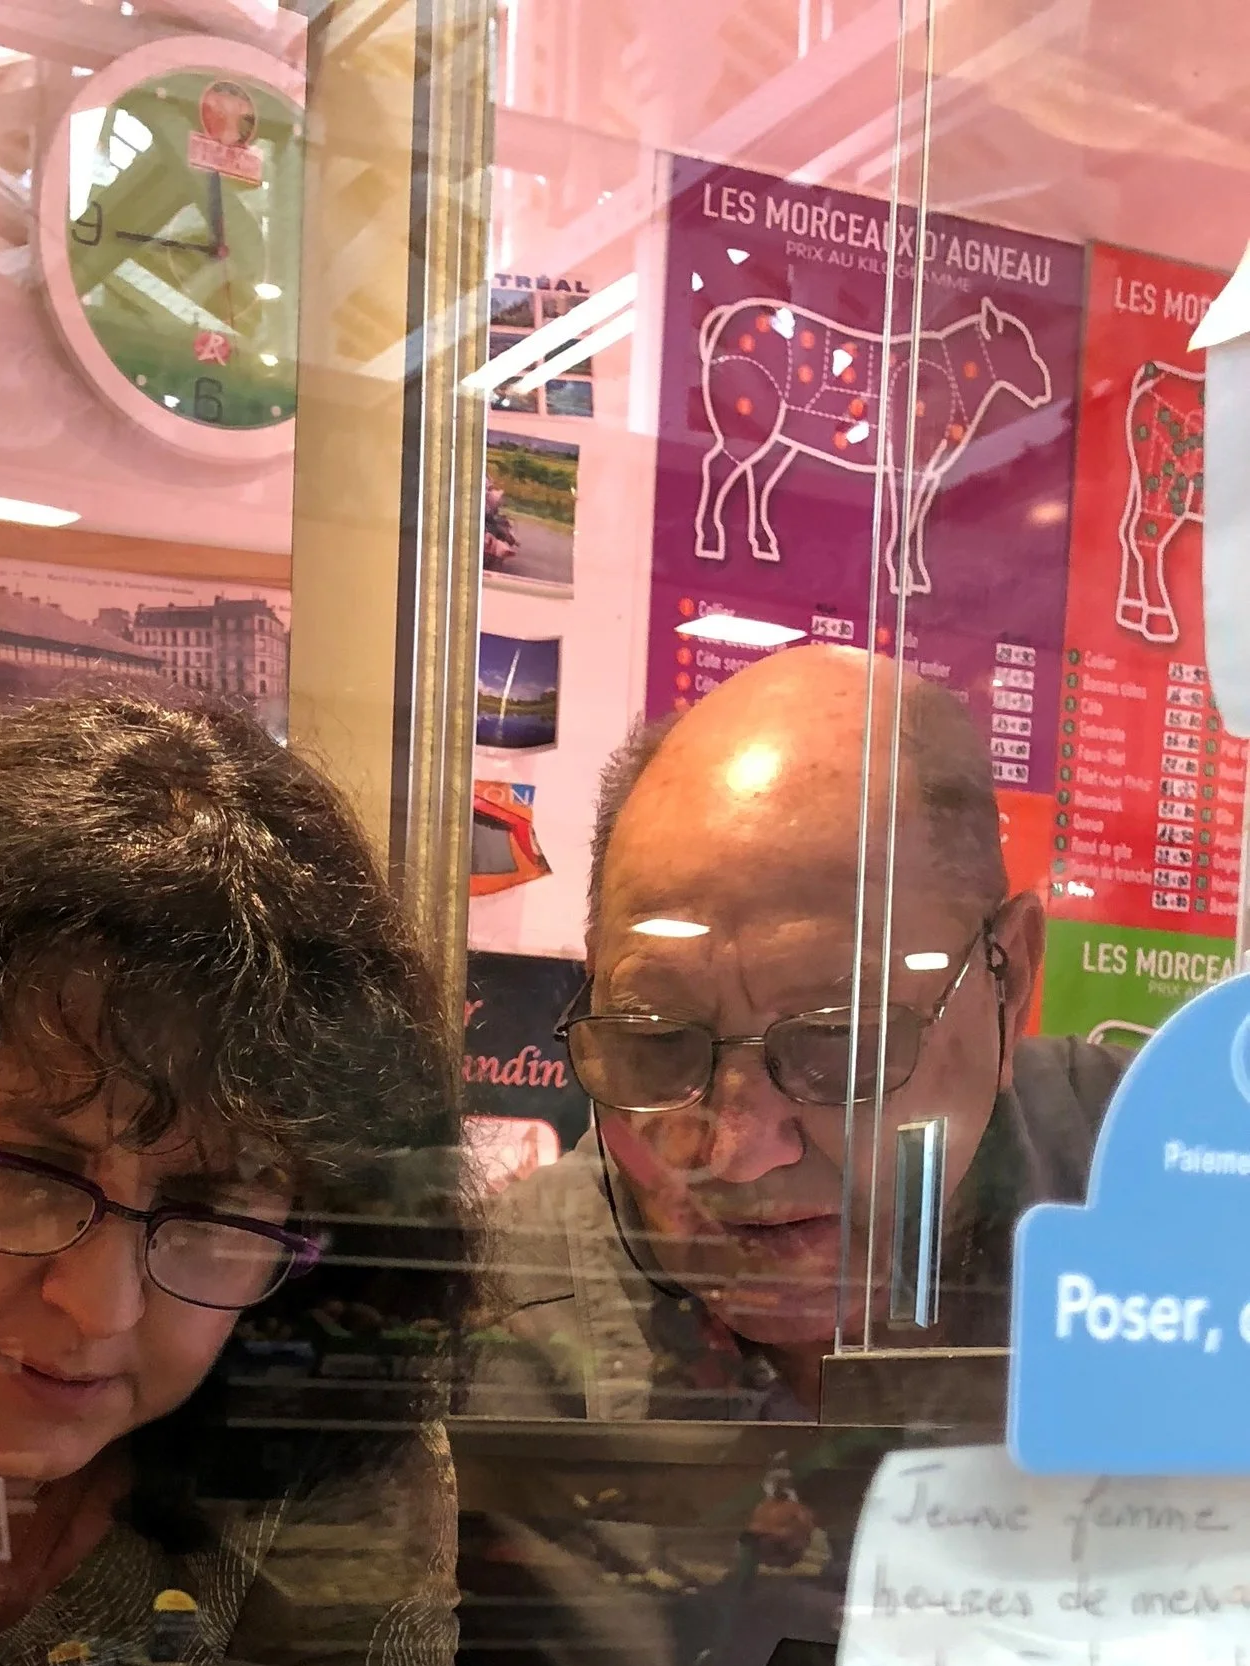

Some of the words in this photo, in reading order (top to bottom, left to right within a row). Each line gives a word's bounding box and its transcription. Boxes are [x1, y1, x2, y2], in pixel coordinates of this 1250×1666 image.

[71, 200, 102, 246] 9
[702, 183, 756, 224] LES
[764, 196, 914, 257] MORCEAUX
[921, 232, 1051, 287] D'AGNEAU
[785, 240, 824, 262] PRIX
[827, 251, 853, 267] AU
[1114, 276, 1157, 315] LES
[195, 376, 224, 422] 6
[1082, 940, 1128, 975] LES
[1055, 1270, 1223, 1354] Poser,
